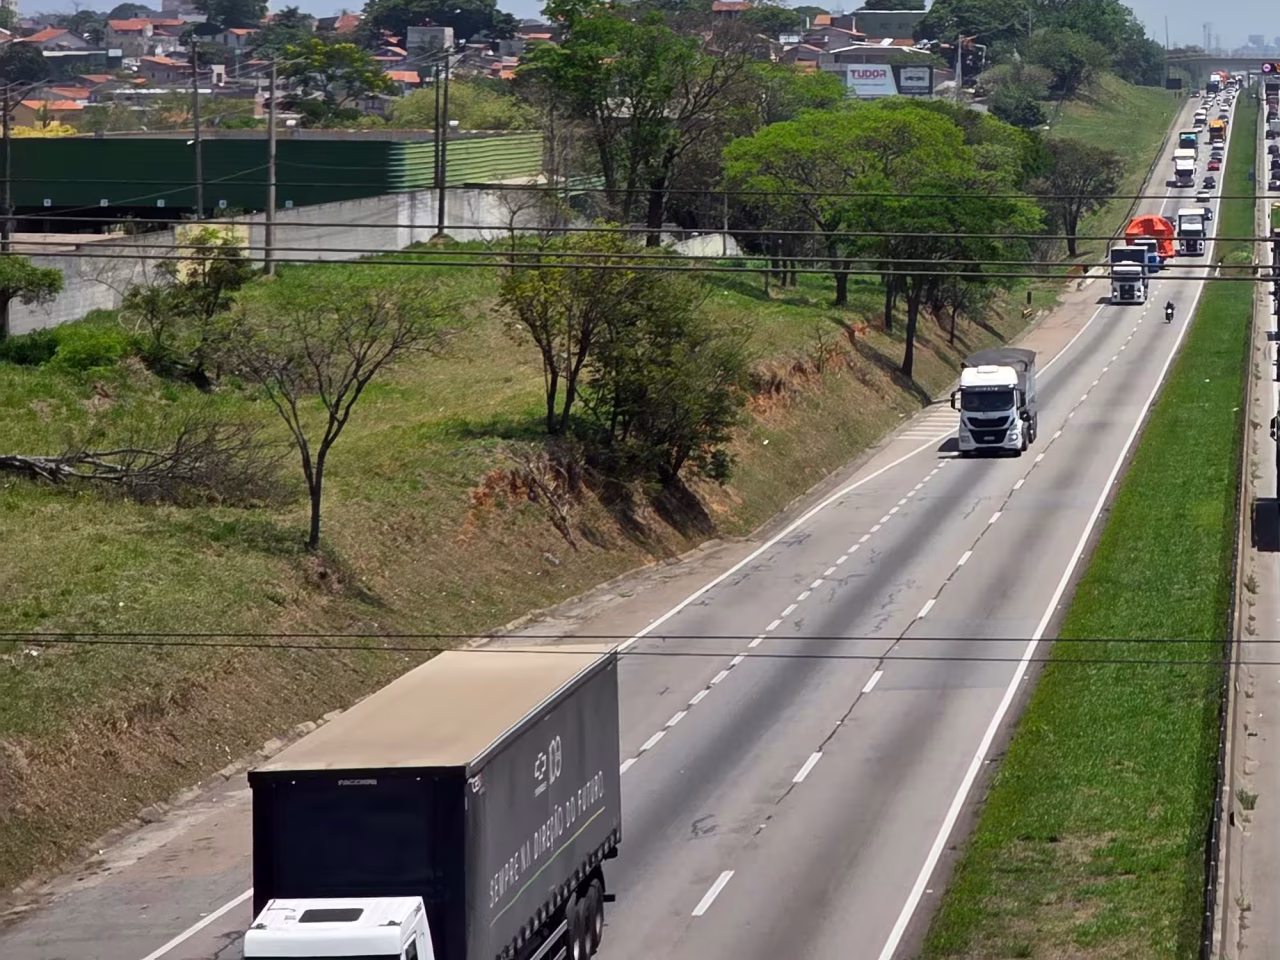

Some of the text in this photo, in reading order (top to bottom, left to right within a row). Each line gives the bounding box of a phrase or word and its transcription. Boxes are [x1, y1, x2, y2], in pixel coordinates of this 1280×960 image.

[850, 69, 887, 79] TUDOR
[489, 770, 605, 908] SEMPRE NA DIREÇÃO DO FUTURO
